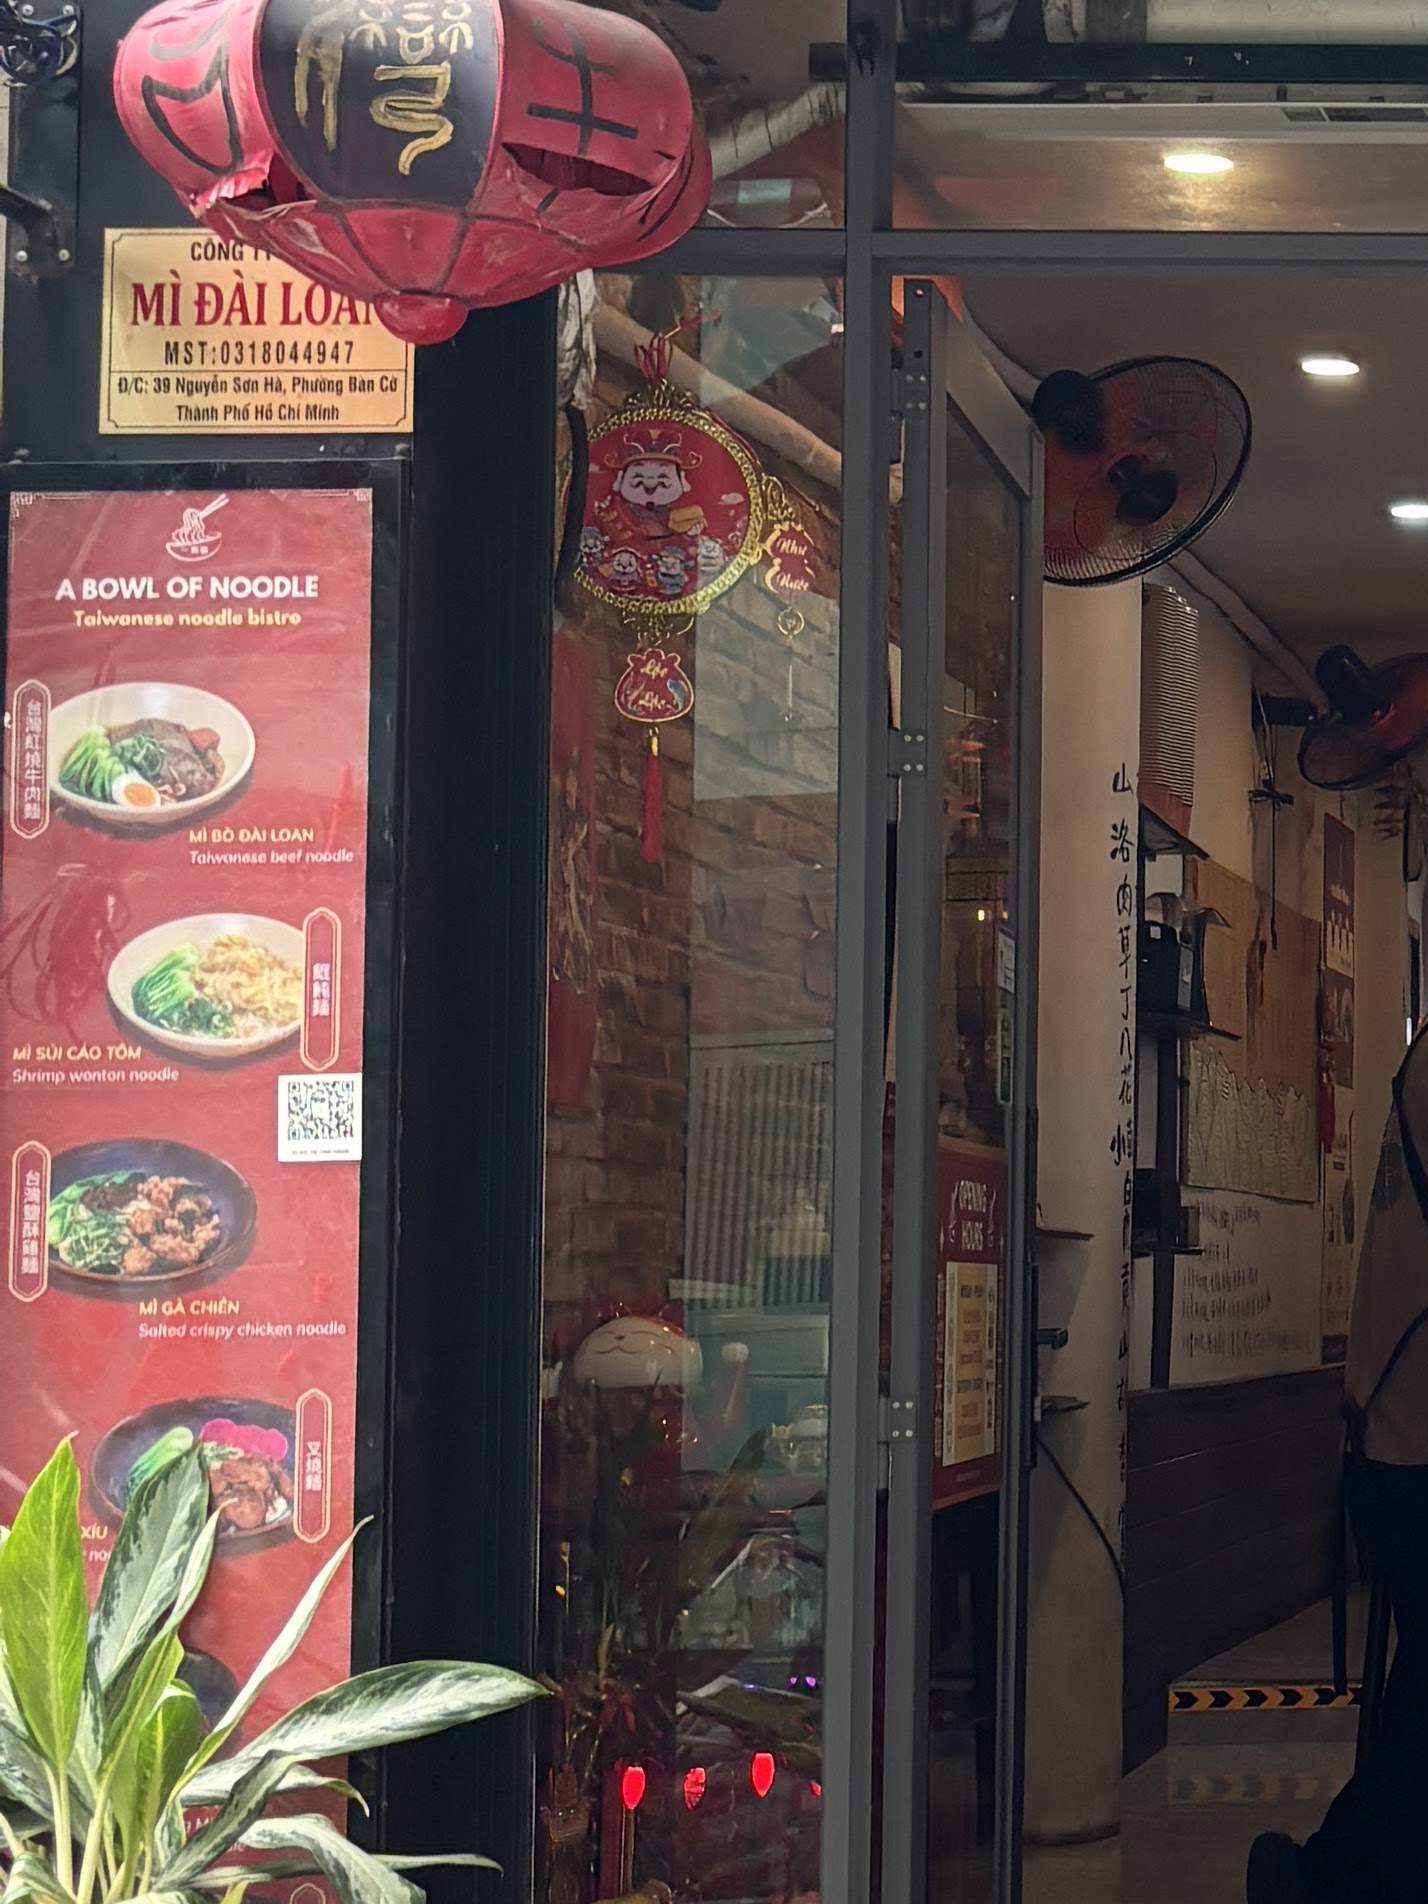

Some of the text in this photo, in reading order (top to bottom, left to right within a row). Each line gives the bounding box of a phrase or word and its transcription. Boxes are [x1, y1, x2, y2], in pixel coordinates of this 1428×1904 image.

[191, 238, 244, 261] CÔNG
[131, 268, 182, 326] MÌ
[194, 268, 267, 326] ĐÀI
[164, 340, 354, 365] MST:0318044947
[118, 375, 398, 397] Đ/C: 39 Nguyễn Sơn Hà, Phường Bàn Cờ
[177, 401, 339, 422] Thành Phố Hồ Chí Minh
[55, 576, 319, 600] A BOWL OF NOODLE
[74, 610, 302, 627] Taiwanese noodle bistro
[189, 826, 314, 843] MÌ BÒ ĐÀI LOAN
[189, 848, 354, 865] Taiwanese beef noodle
[12, 1045, 32, 1061] MÌ
[106, 1044, 141, 1060] TÔM
[12, 1068, 179, 1086] Shrimp wonton noodle
[139, 1298, 157, 1315] MÌ
[162, 1298, 186, 1315] GÀ
[138, 1321, 346, 1341] Salted crispy chicken noodle
